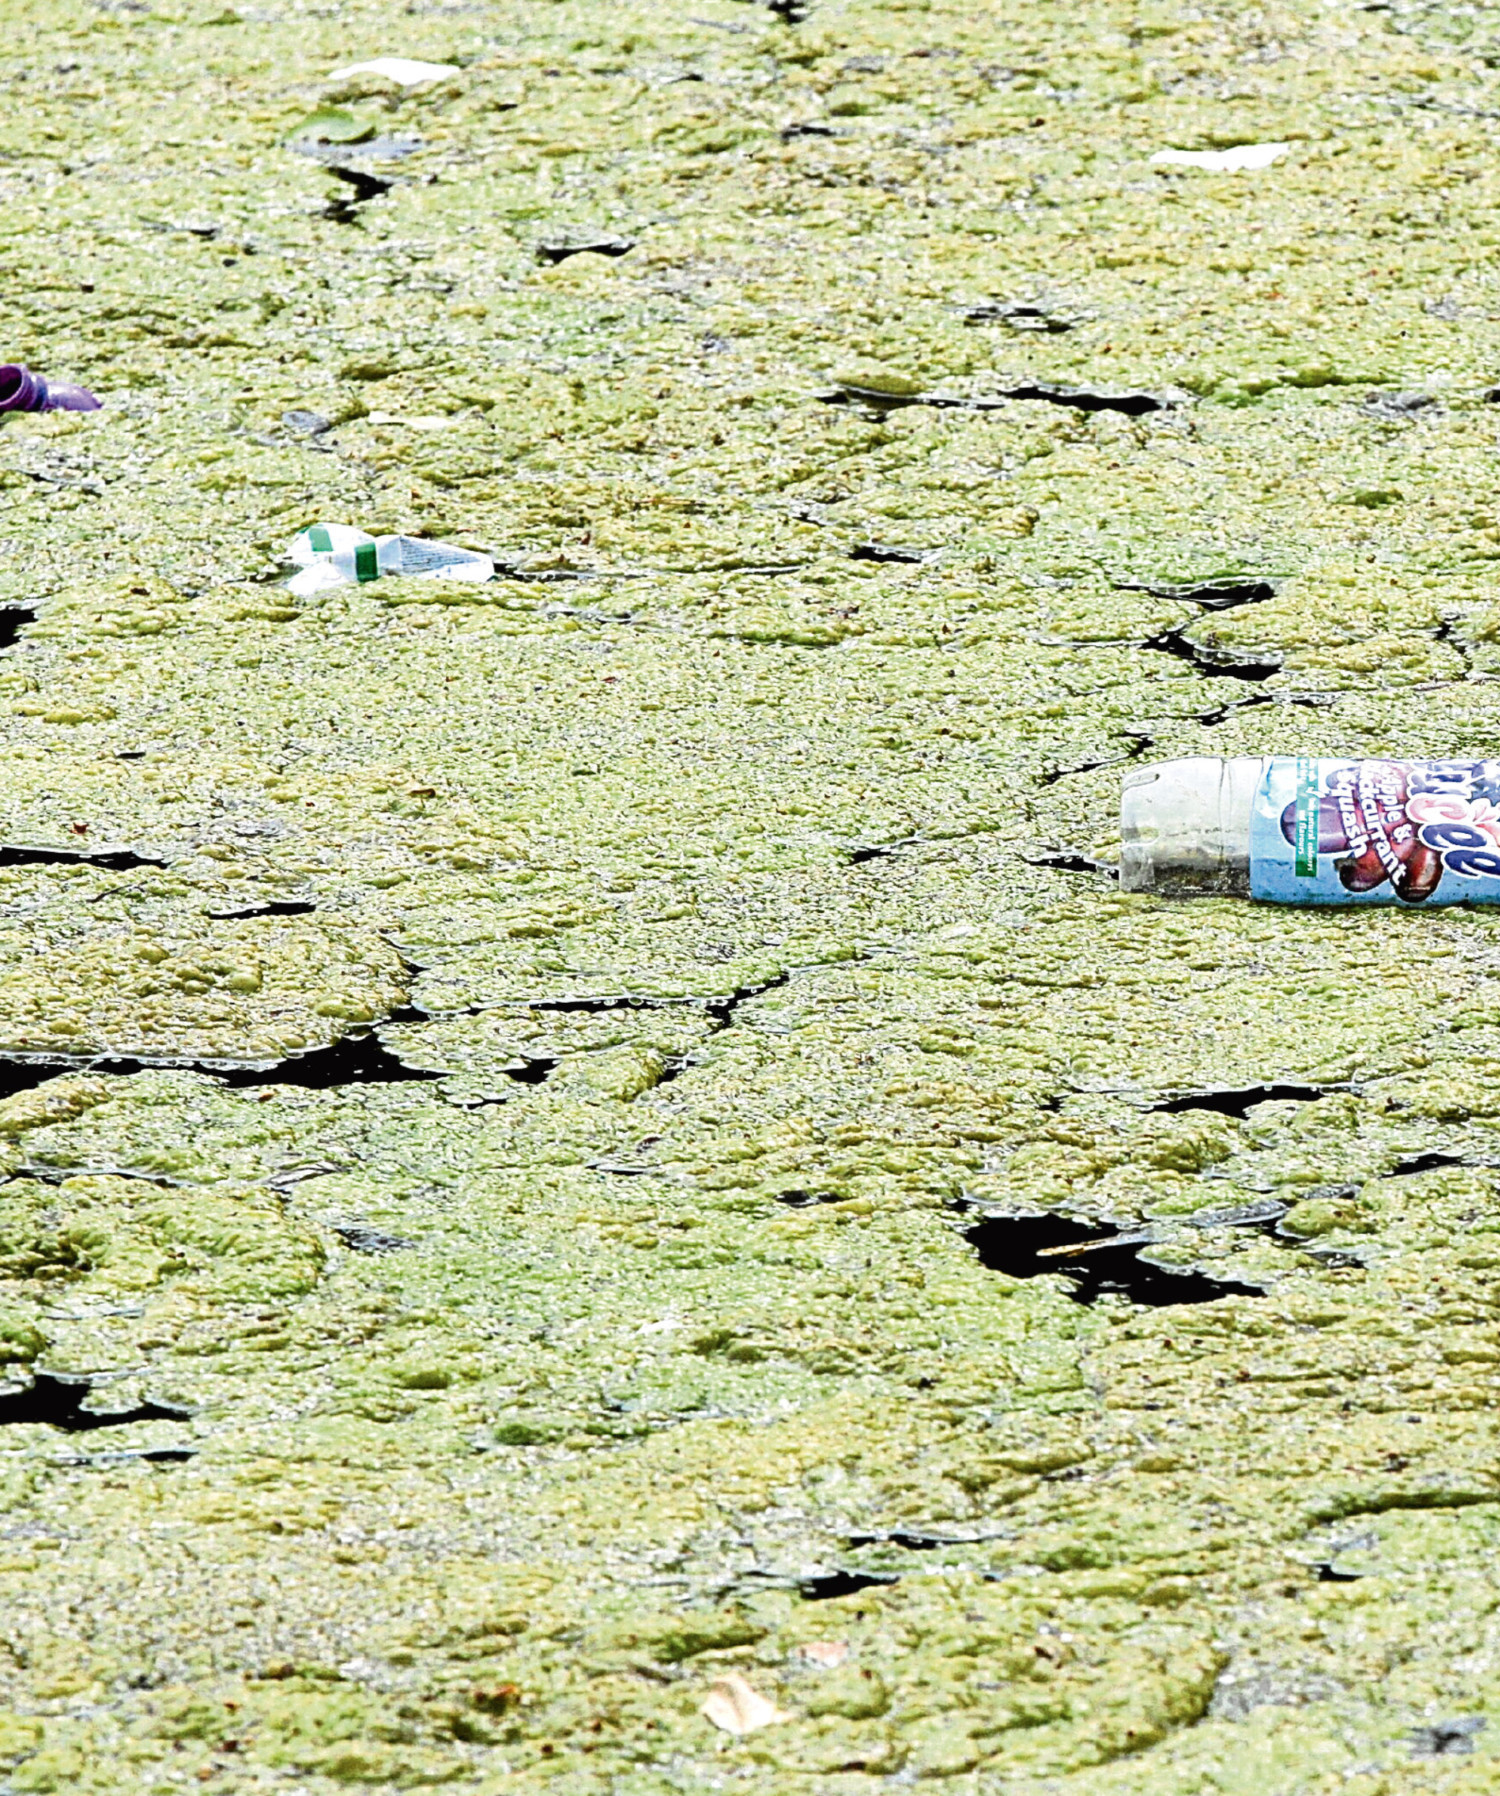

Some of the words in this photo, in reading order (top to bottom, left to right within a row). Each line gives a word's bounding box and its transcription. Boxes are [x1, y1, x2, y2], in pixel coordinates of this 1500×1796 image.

[1375, 774, 1404, 822] Apple
[1392, 823, 1412, 843] &
[1298, 822, 1306, 855] flavours
[1307, 811, 1316, 840] natural
